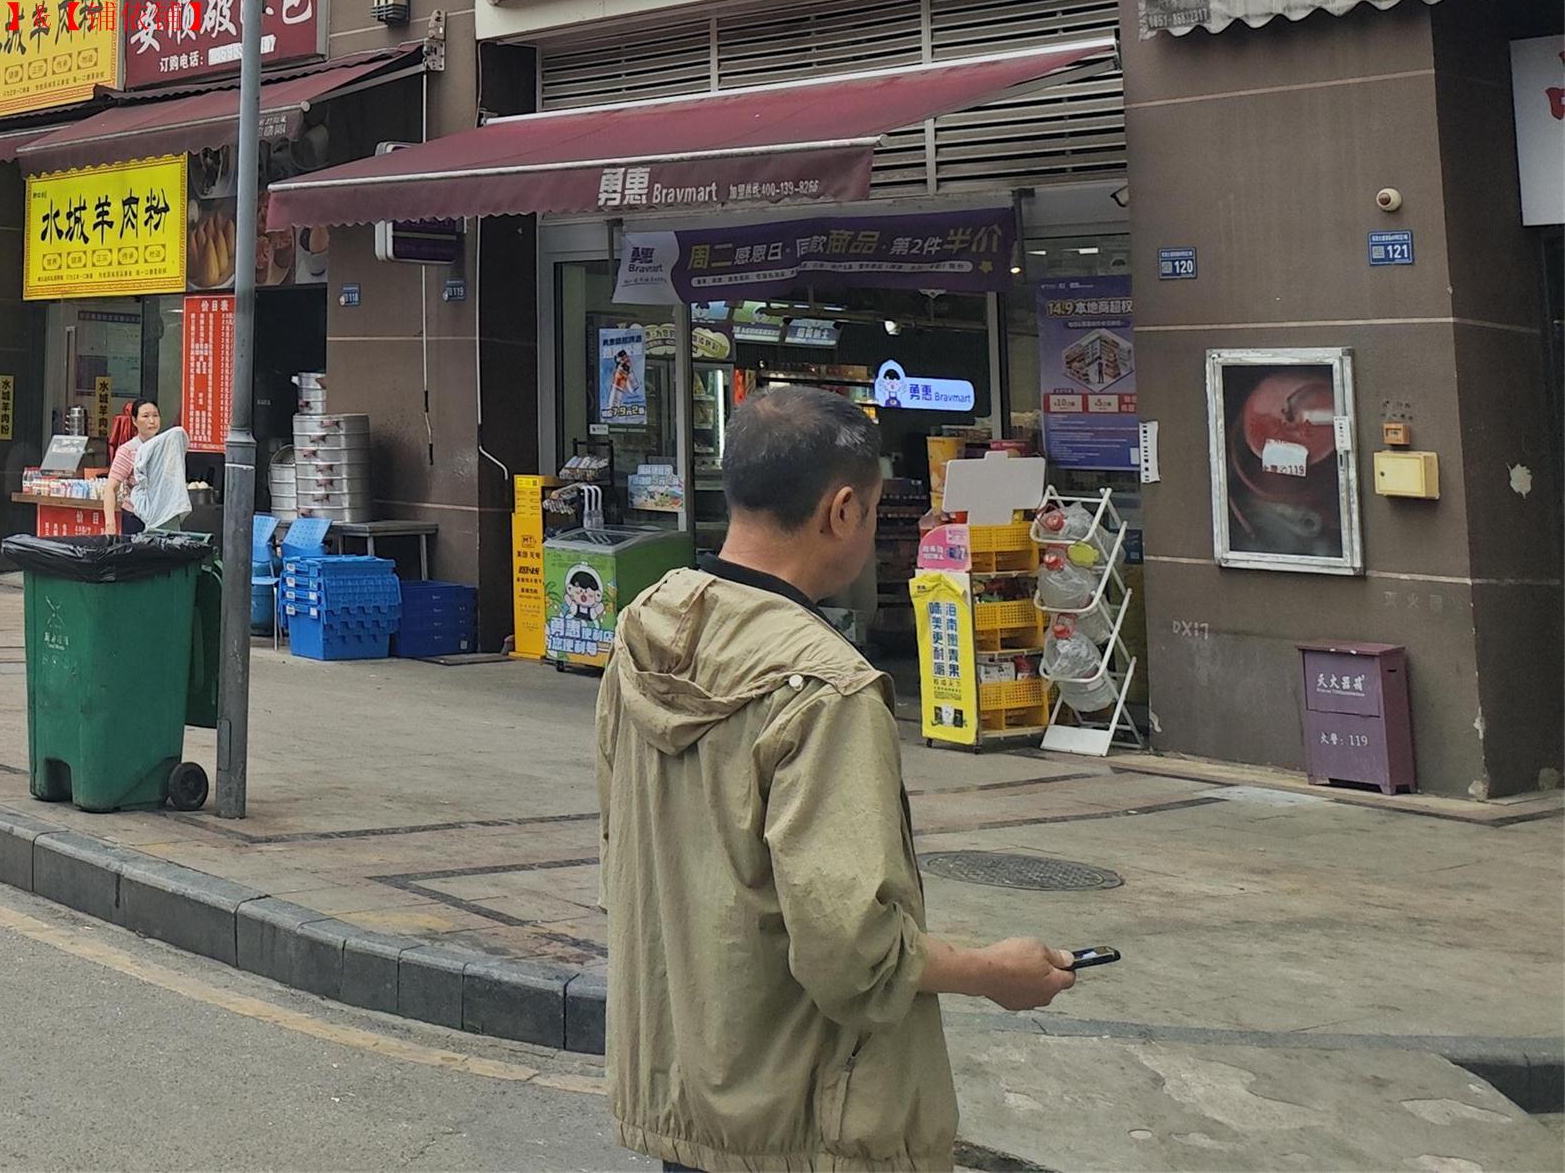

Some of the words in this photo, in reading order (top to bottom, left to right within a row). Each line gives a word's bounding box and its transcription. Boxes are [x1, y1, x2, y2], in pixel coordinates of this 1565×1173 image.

[652, 182, 718, 203] Bravmart
[40, 187, 171, 246] 水城羊肉粉
[1386, 244, 1409, 259] 121
[1174, 260, 1193, 274] 120
[934, 392, 972, 404] Bravmart
[1287, 464, 1305, 476] 119
